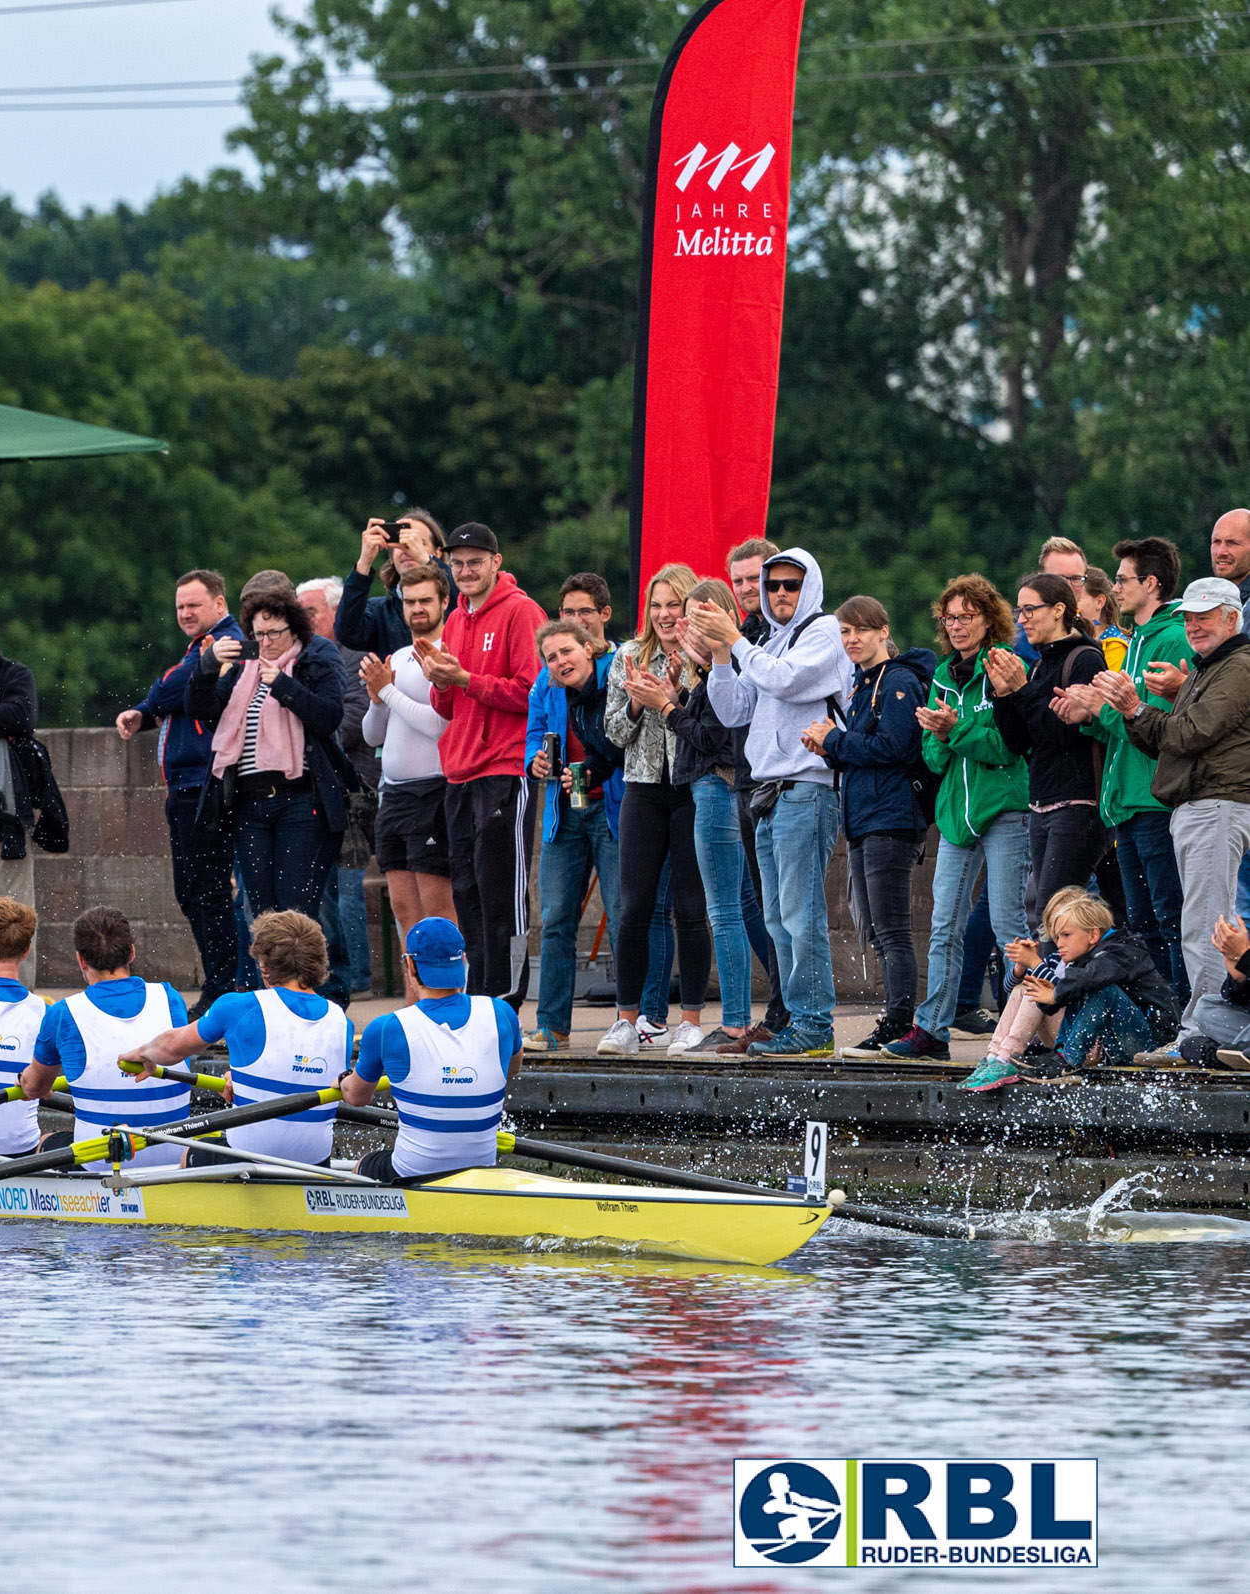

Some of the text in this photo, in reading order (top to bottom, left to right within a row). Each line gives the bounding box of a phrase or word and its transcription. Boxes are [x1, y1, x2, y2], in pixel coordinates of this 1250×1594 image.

[676, 203, 772, 223] JAHRE
[674, 226, 774, 256] Melitta
[483, 632, 495, 652] H
[183, 1121, 204, 1131] Thiem
[811, 1126, 821, 1176] 9
[30, 1187, 110, 1213] Maschseeachter
[314, 1190, 407, 1210] RBL RUDER-BUNDESLIGA
[596, 1201, 639, 1213] Wolfram Thiem
